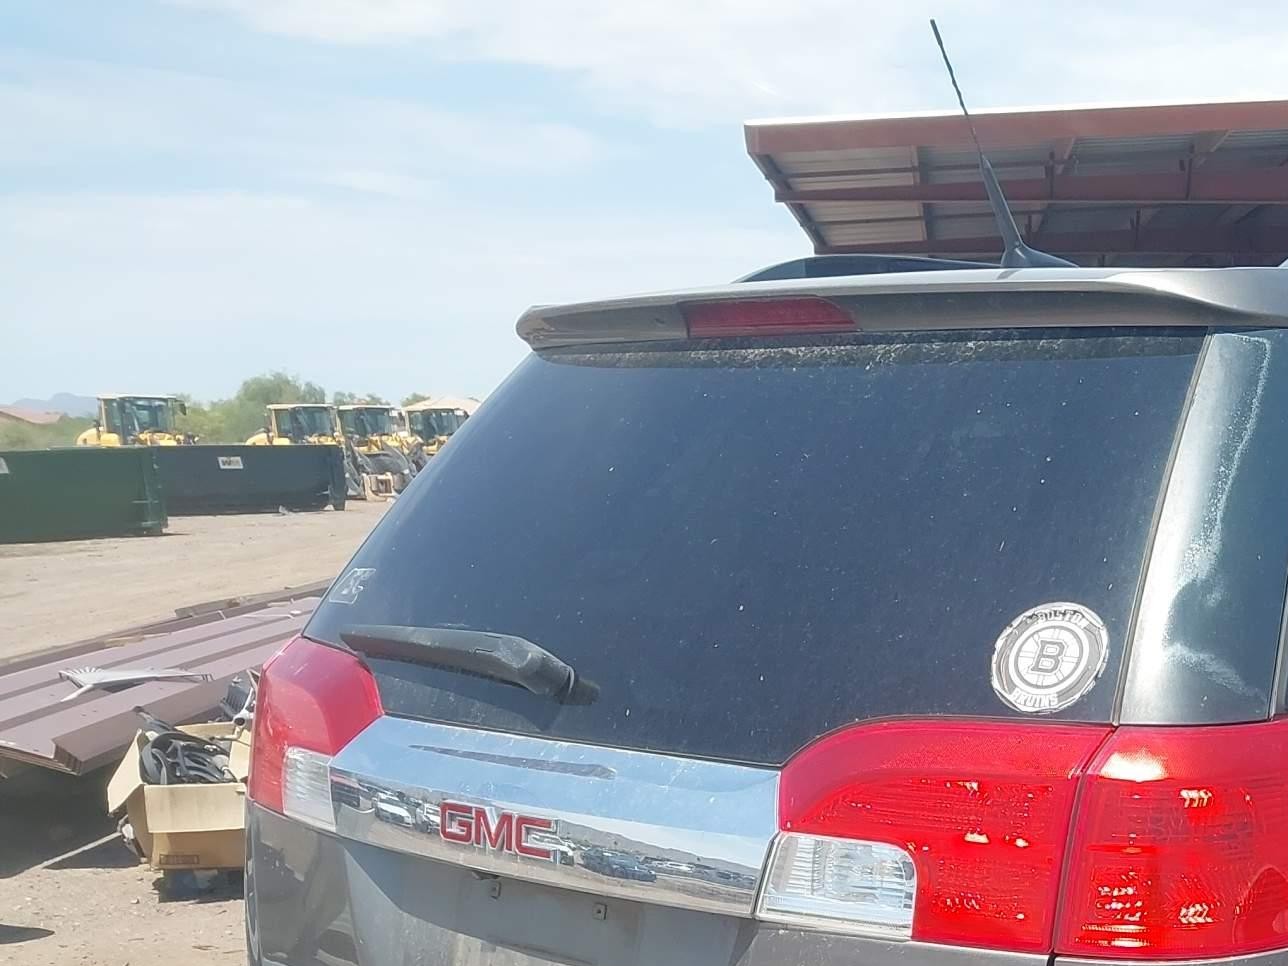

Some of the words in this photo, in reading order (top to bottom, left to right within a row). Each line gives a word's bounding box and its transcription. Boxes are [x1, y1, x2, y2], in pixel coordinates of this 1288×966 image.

[1028, 638, 1067, 674] B
[1009, 687, 1059, 708] BRUINS
[440, 800, 556, 861] GMC
